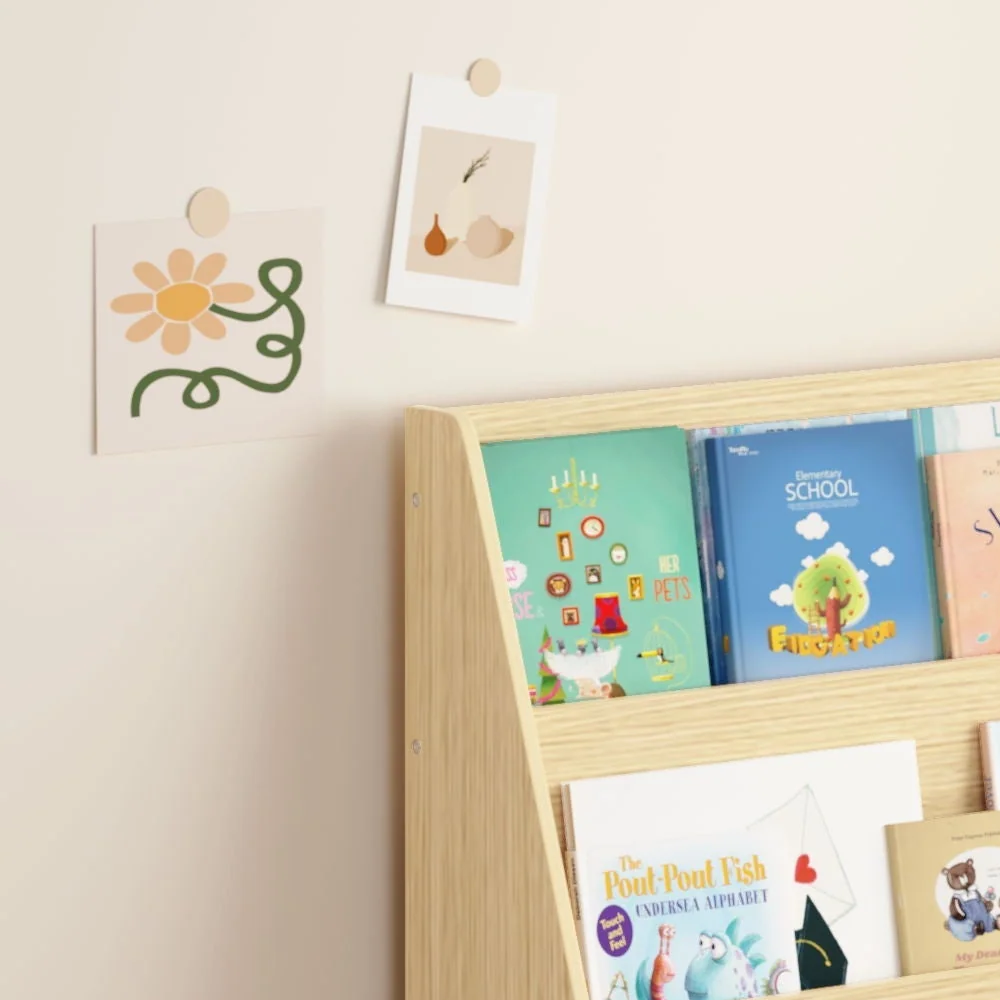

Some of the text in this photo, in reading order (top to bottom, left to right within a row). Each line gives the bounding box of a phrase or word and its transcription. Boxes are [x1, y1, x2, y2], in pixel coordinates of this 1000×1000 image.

[795, 469, 842, 481] Elementary
[785, 478, 859, 501] SCHOOL
[653, 576, 692, 602] PETS
[618, 855, 642, 873] The
[602, 859, 717, 901] Pout-Pout
[719, 854, 768, 886] Fish
[635, 889, 769, 918] UNDERSEA ALPHABET
[600, 911, 625, 931] Touch
[608, 924, 624, 941] and
[609, 935, 627, 952] Feel
[955, 953, 973, 964] My
